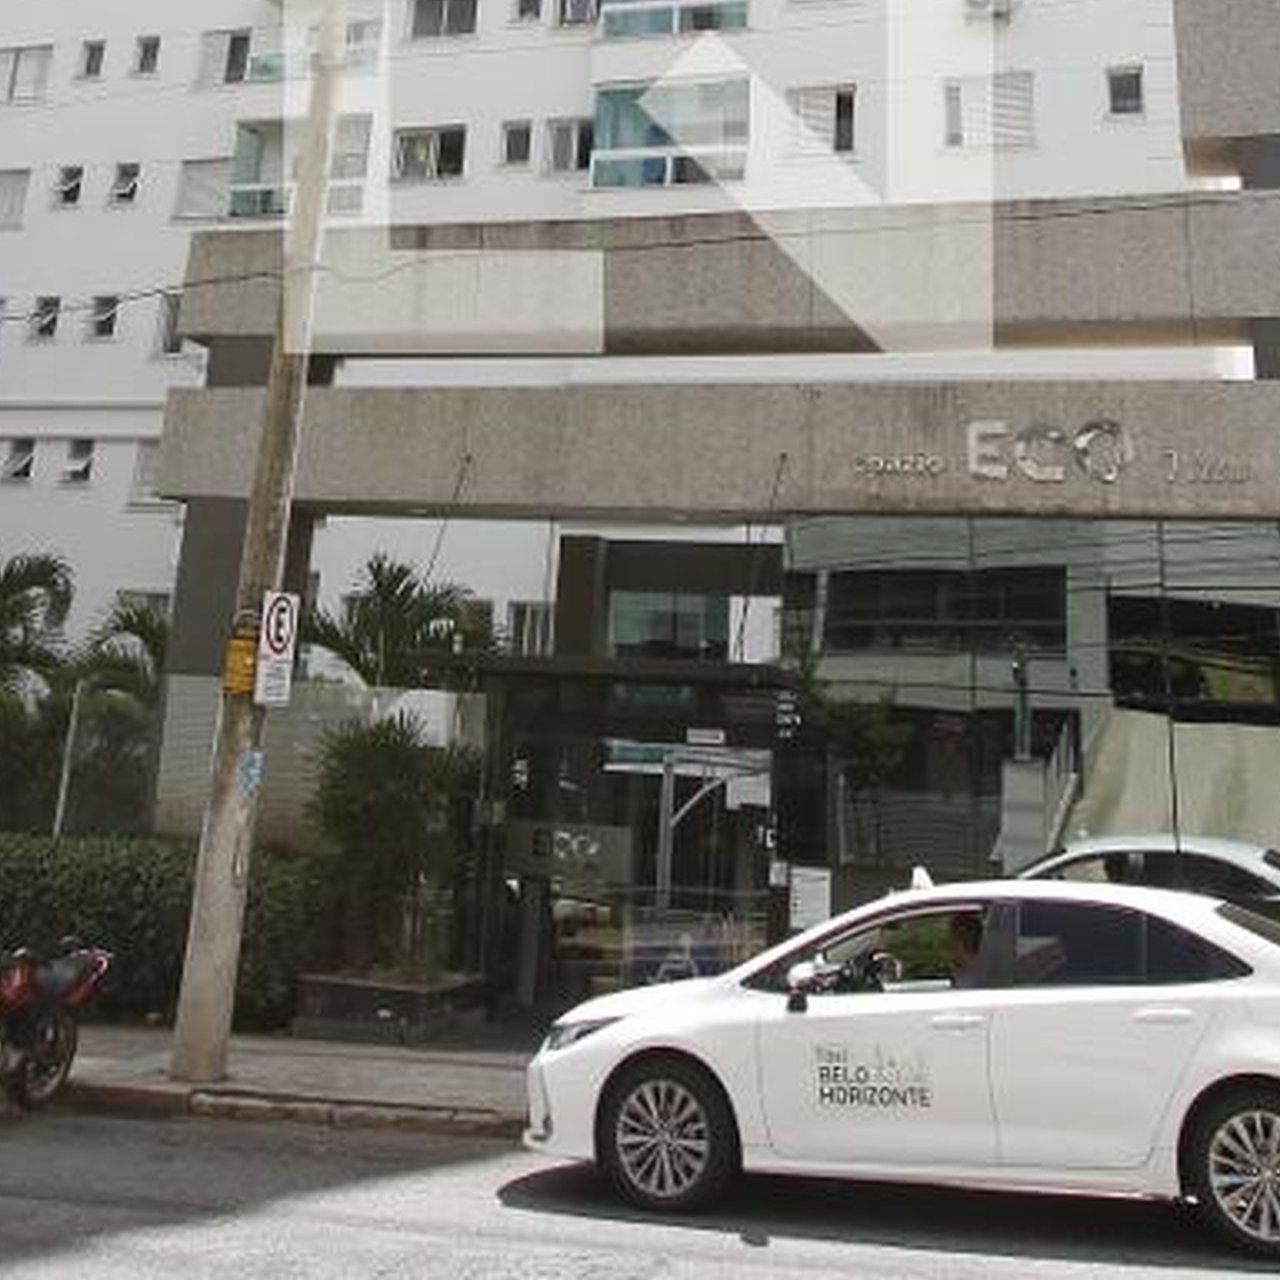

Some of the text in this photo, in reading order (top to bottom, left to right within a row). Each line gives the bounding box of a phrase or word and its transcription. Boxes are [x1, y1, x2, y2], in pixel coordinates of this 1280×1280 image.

[967, 418, 1133, 484] ECO
[818, 1065, 870, 1084] BELO
[818, 1085, 933, 1108] HORIZONTE
